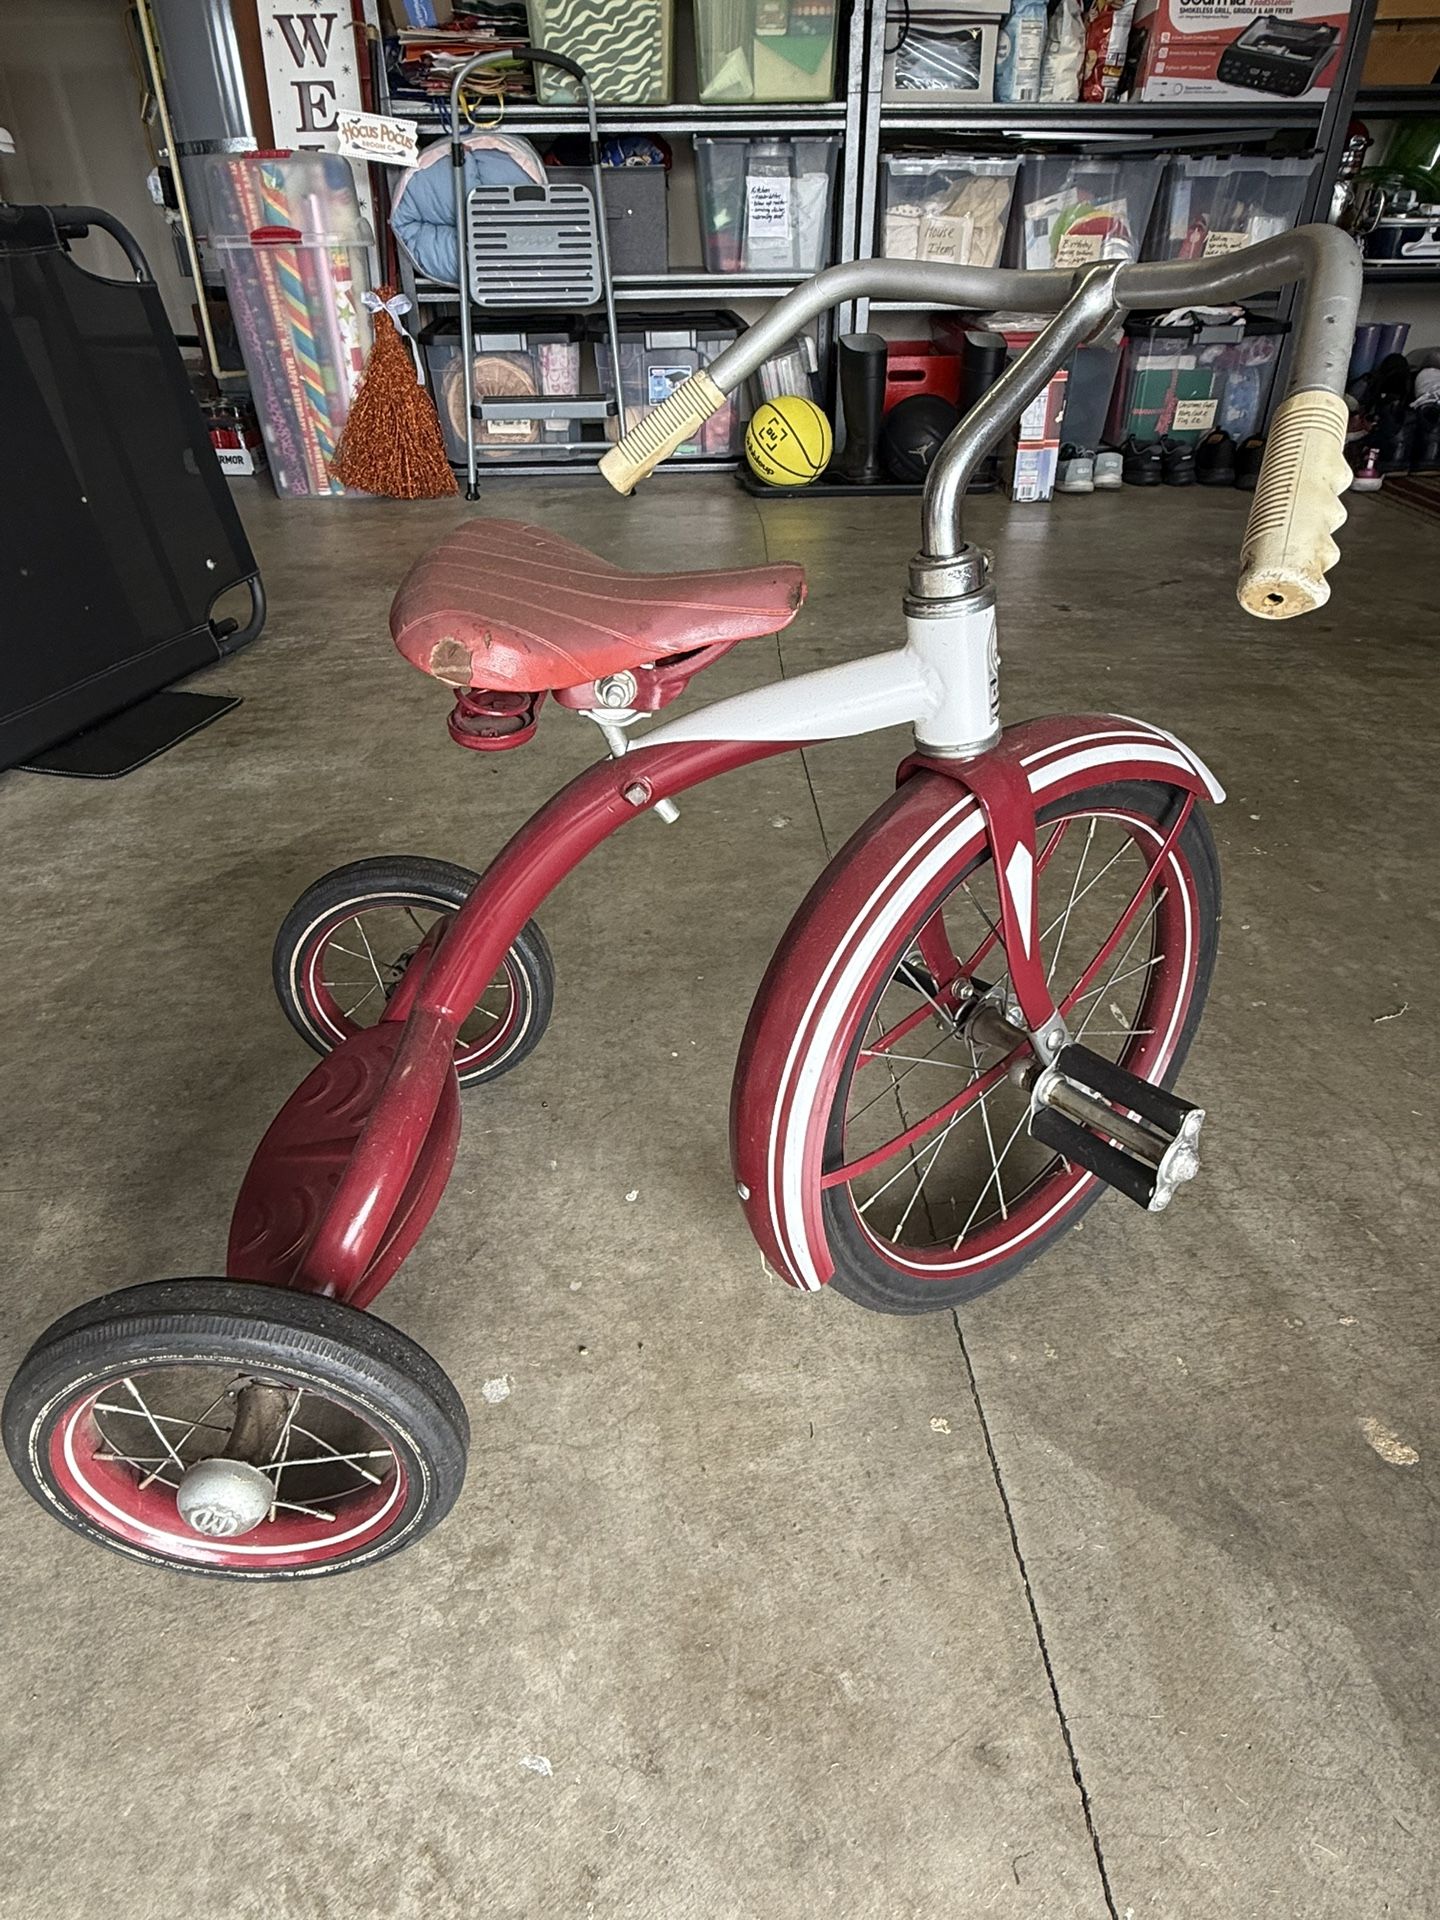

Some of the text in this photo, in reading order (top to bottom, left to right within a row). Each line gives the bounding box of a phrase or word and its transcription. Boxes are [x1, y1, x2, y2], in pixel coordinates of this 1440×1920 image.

[925, 224, 955, 239] House
[928, 242, 956, 257] Items
[218, 455, 245, 465] RMOR
